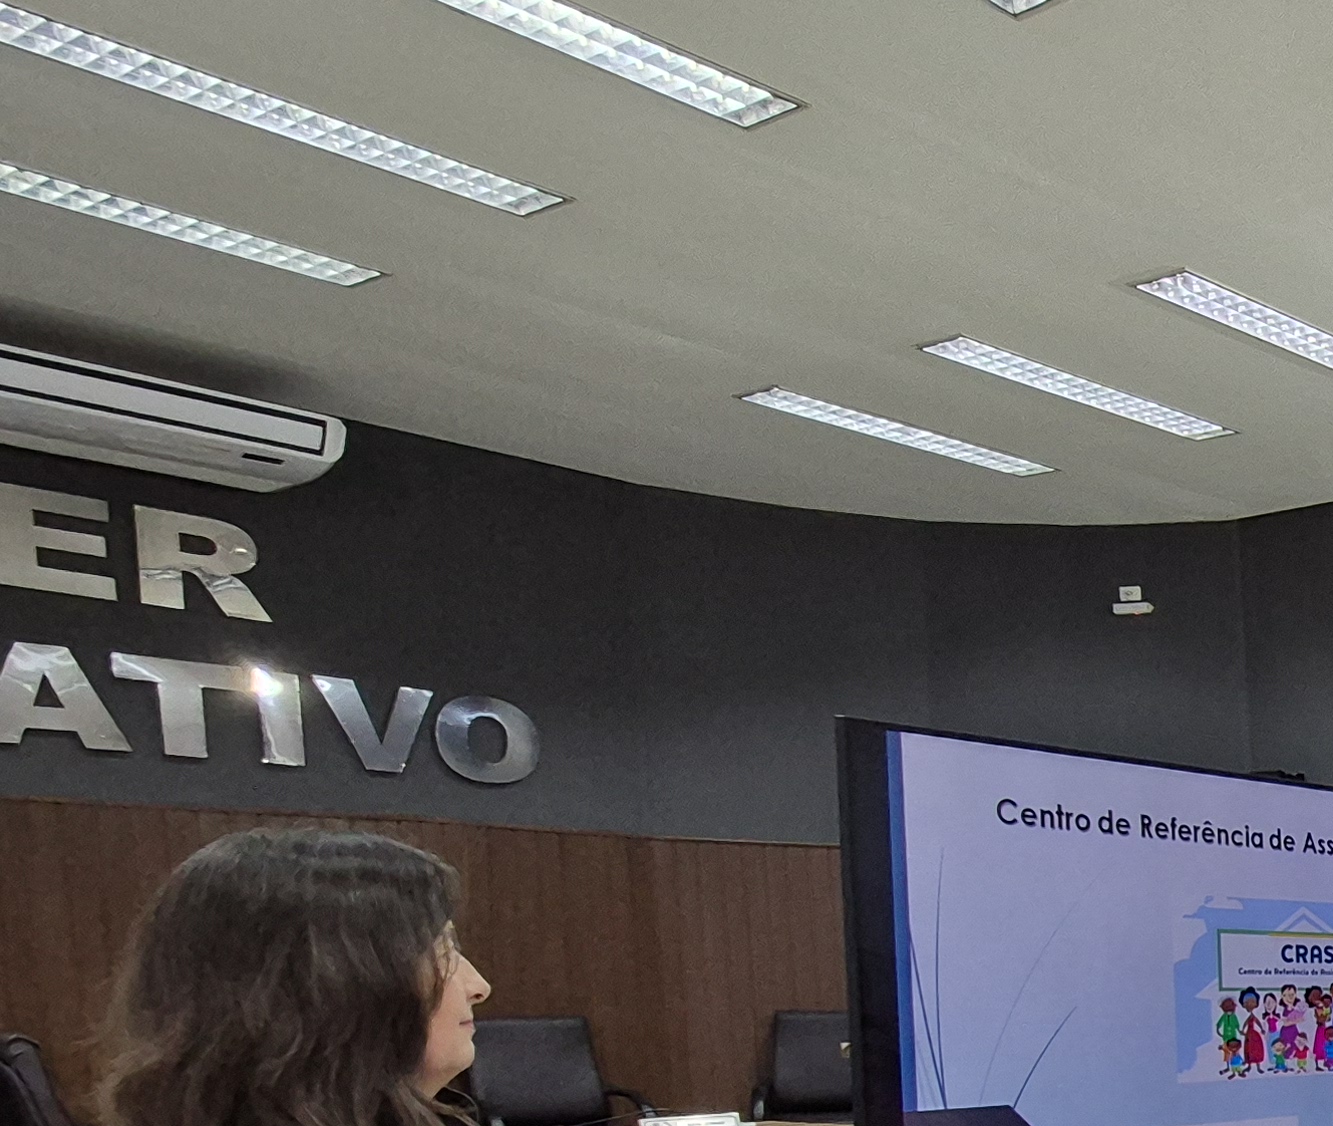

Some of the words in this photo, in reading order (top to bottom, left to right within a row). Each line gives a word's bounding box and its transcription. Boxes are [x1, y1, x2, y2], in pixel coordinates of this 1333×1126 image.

[0, 640, 540, 784] ATIVO
[996, 798, 1091, 832] Centro
[1098, 809, 1131, 835] de
[1140, 813, 1264, 849] Referência
[1269, 828, 1296, 851] de
[1238, 967, 1262, 976] Centro
